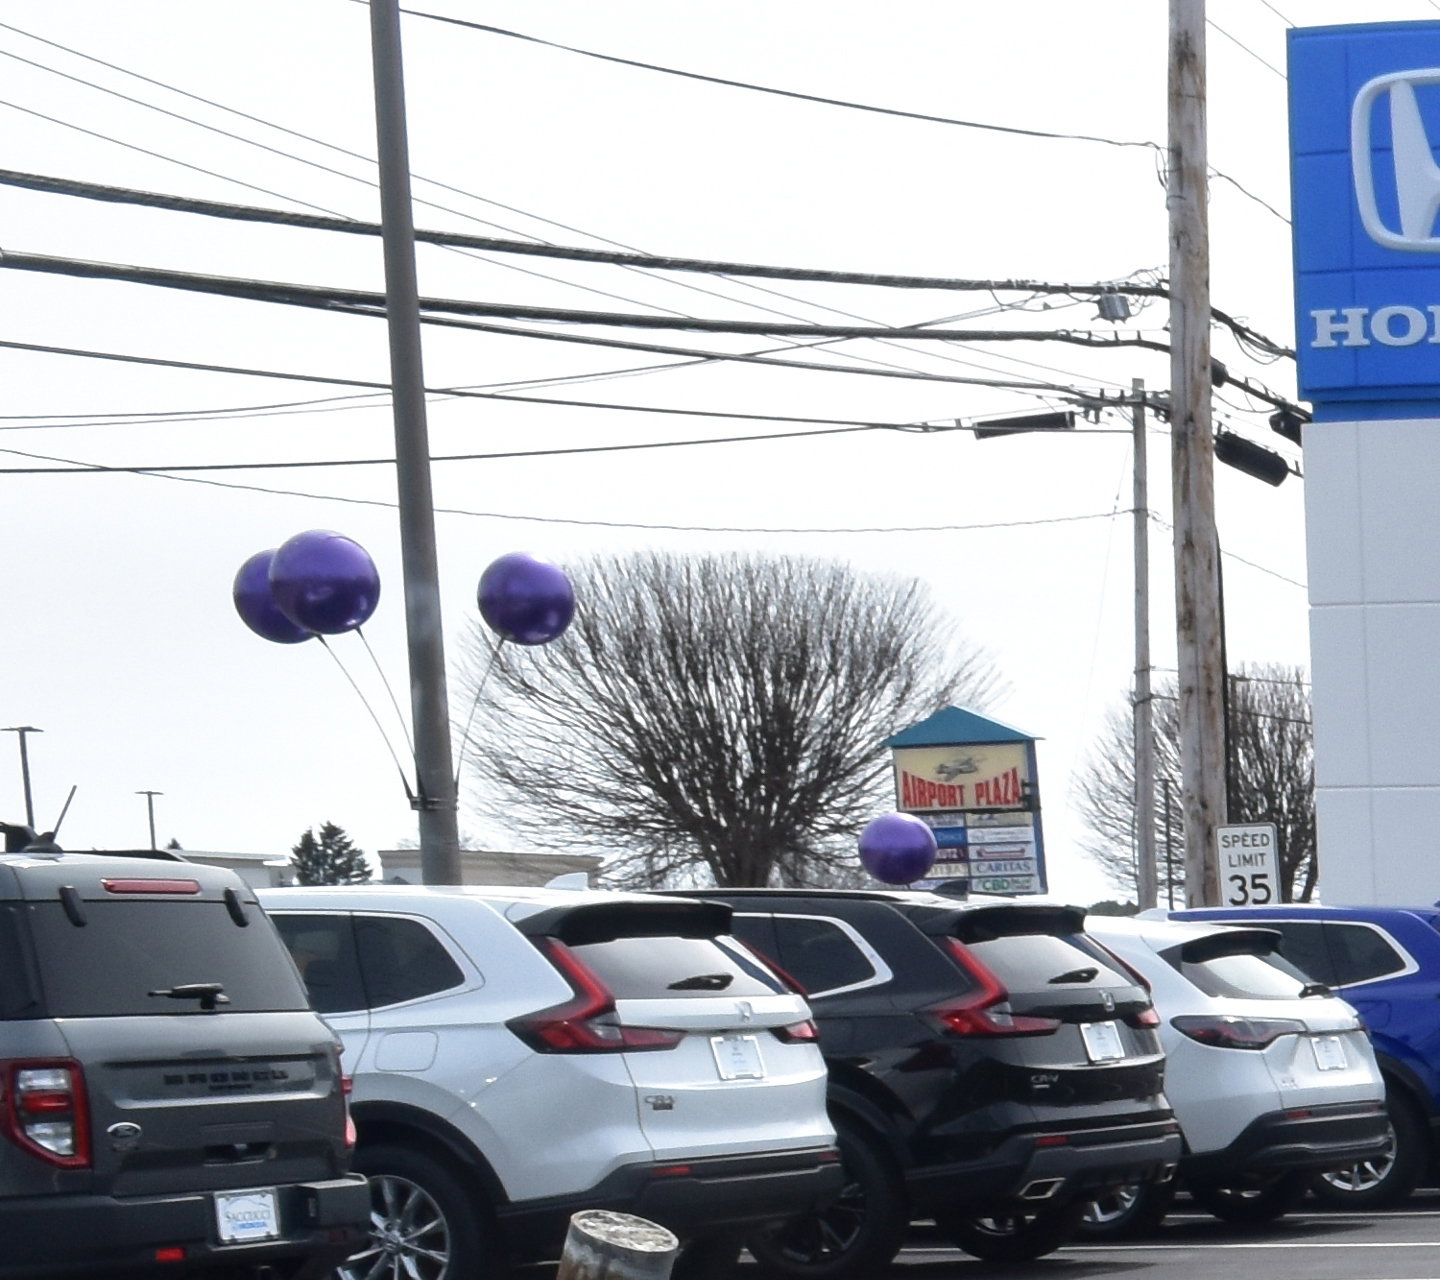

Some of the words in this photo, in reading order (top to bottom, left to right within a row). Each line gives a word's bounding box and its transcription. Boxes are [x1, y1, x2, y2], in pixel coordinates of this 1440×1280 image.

[902, 770, 965, 808] AIRPORT
[974, 766, 1021, 806] PLAZA
[1221, 832, 1271, 849] SPEED
[976, 860, 1031, 874] CARITAS
[1228, 852, 1266, 868] LIMIT
[982, 879, 1010, 891] CBD
[1228, 873, 1272, 906] 35
